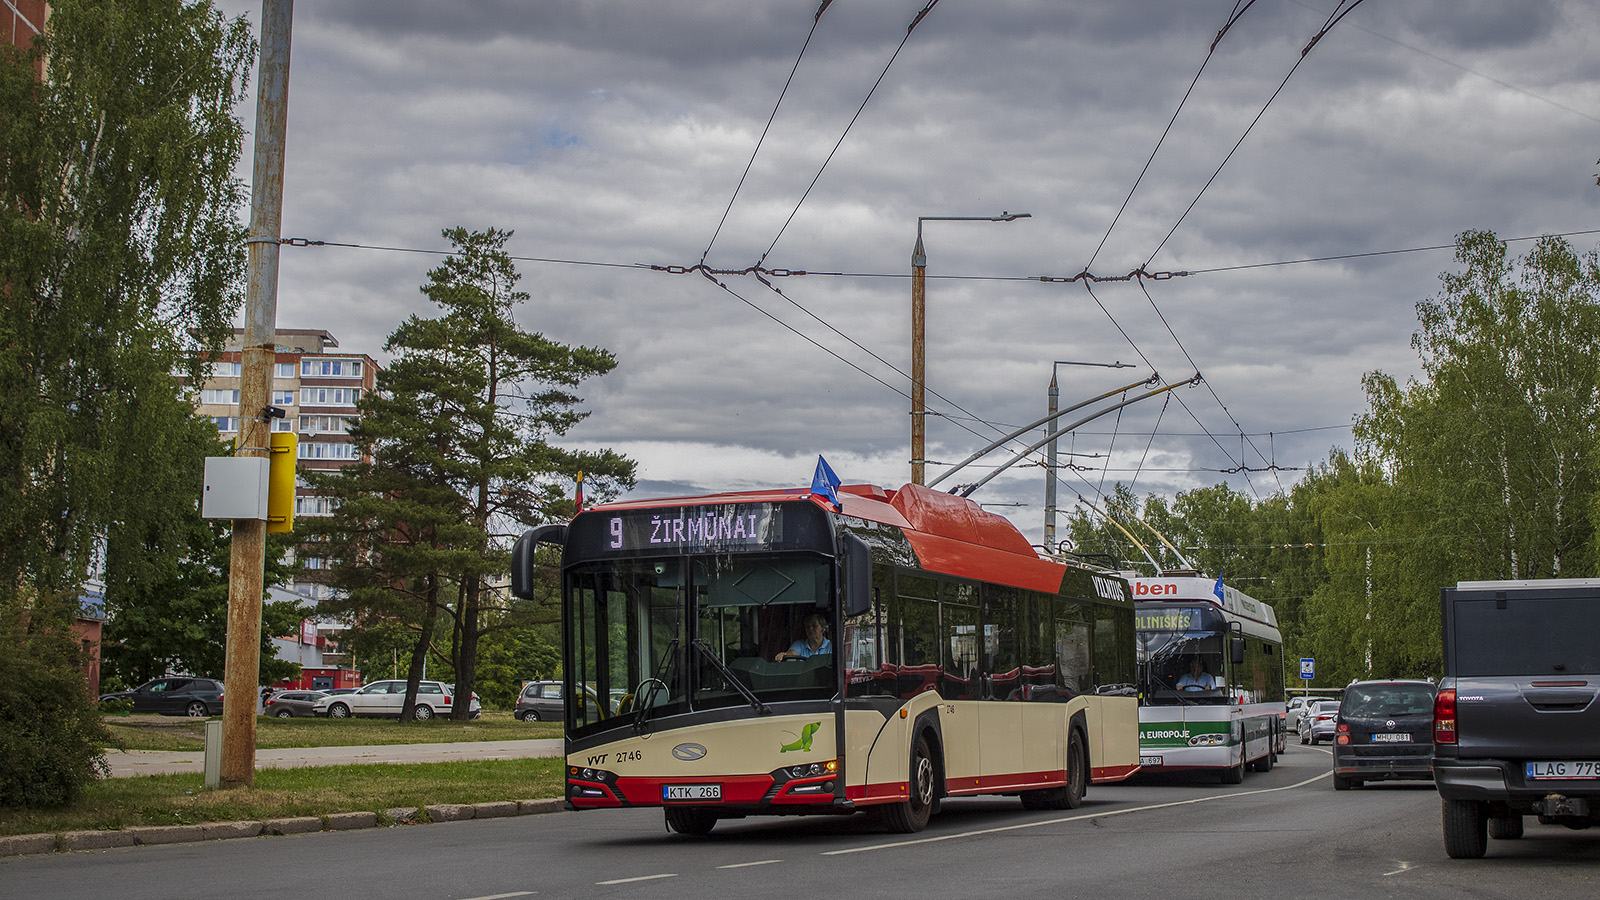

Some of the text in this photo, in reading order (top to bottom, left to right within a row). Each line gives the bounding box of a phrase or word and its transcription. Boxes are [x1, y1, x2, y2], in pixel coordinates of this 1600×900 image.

[610, 512, 757, 549] 9 ŽIRMŪNAI
[1091, 575, 1125, 603] VILNIUS
[1147, 730, 1190, 739] EUROPOJE
[587, 750, 642, 766] VVT 2746
[1535, 763, 1600, 775] LAG 778
[669, 786, 719, 798] KTK 266
